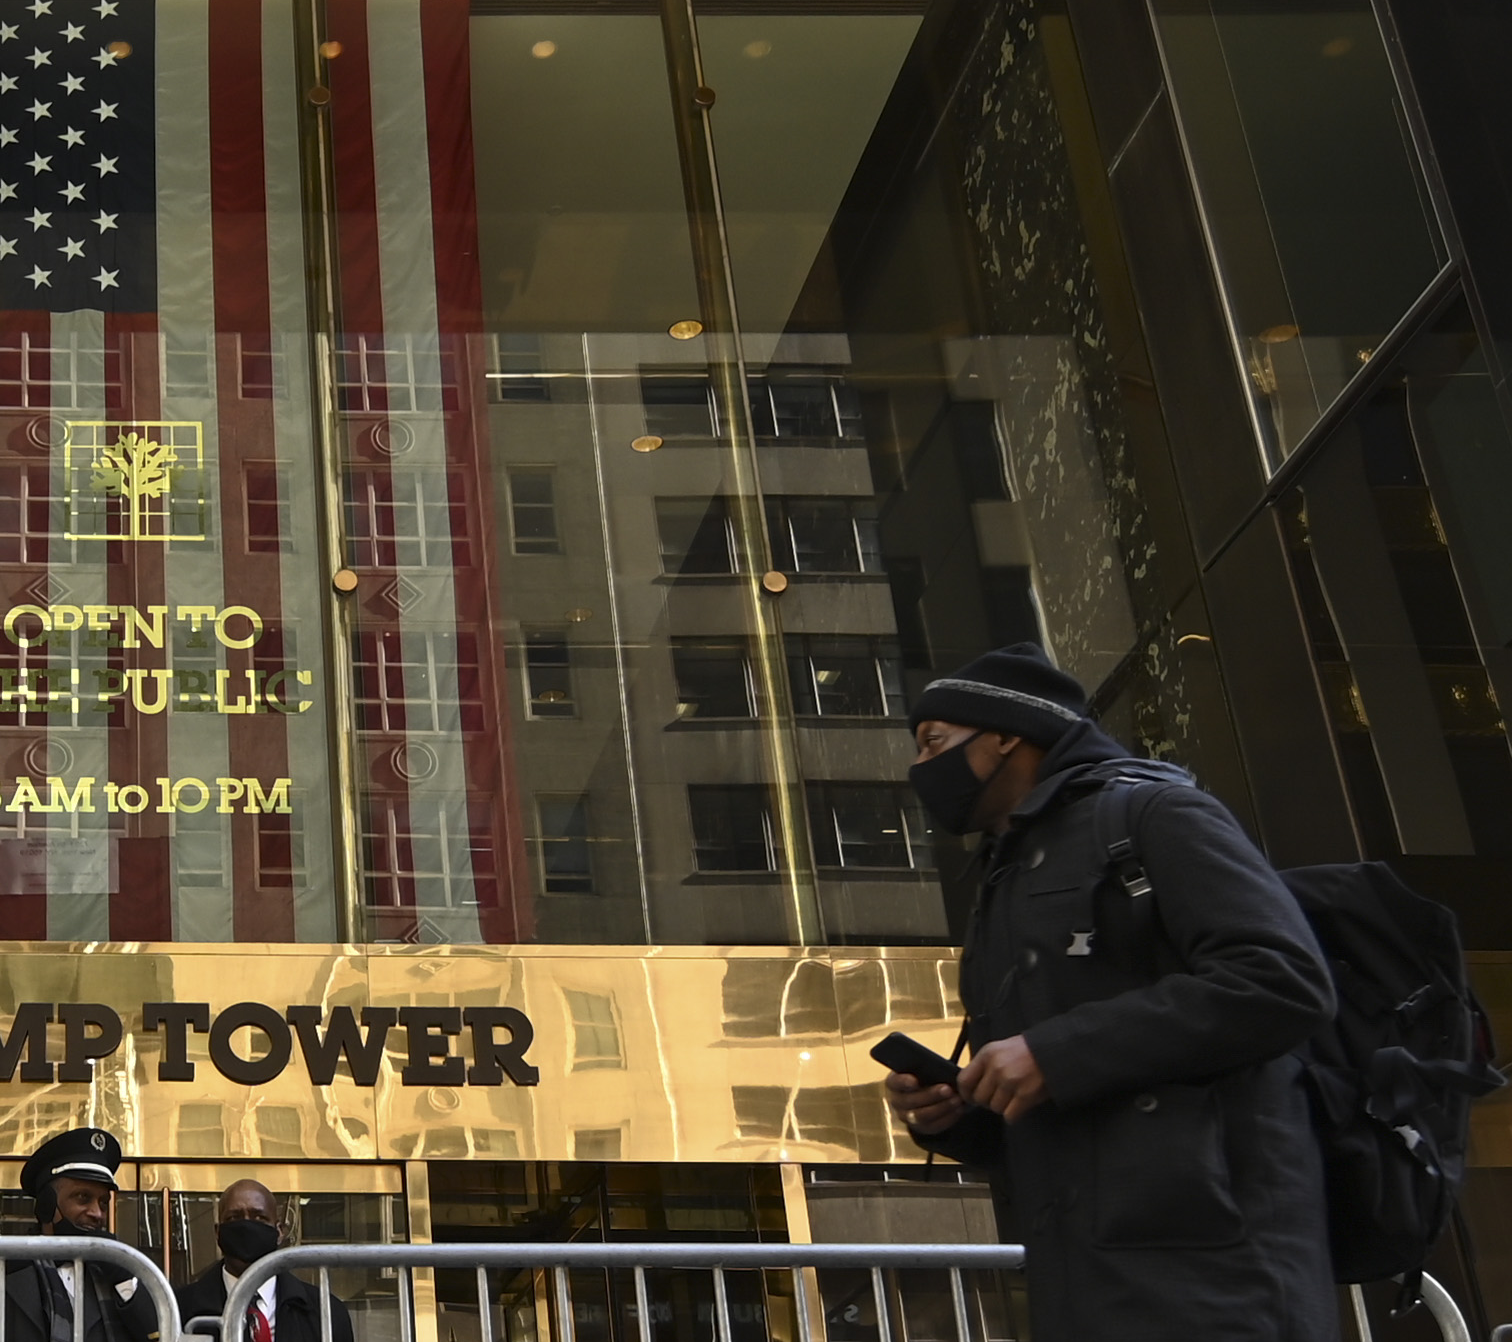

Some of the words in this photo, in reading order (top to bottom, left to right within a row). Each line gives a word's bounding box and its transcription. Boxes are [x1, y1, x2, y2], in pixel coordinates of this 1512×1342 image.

[3, 604, 167, 649] OPEN
[178, 604, 264, 649] TO
[92, 667, 314, 715] PUBLIC
[103, 780, 149, 814] to
[142, 1000, 541, 1088] TOWER
